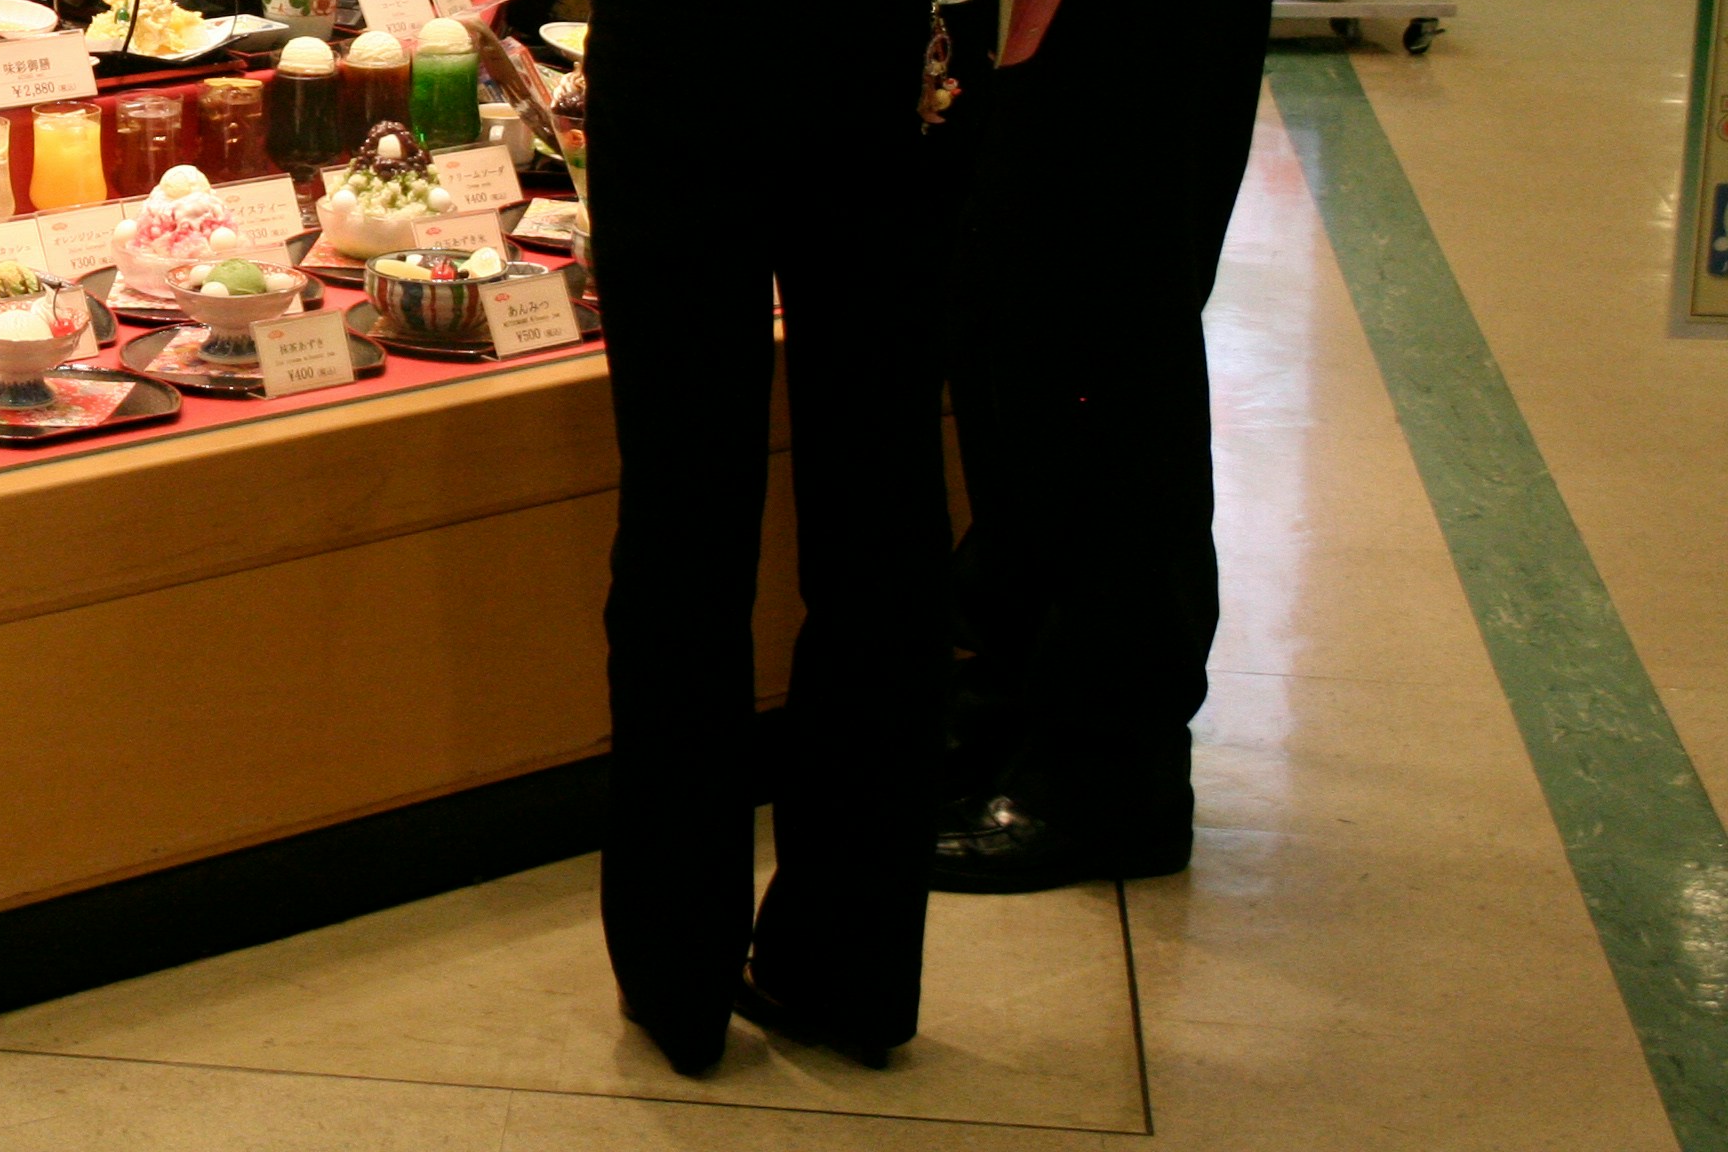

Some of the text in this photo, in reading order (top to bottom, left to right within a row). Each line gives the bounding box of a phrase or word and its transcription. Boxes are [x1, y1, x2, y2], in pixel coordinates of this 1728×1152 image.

[10, 81, 56, 98] ¥2,880
[507, 299, 550, 318] あんみつ
[515, 327, 541, 343] ¥500
[287, 365, 315, 382] ¥400
